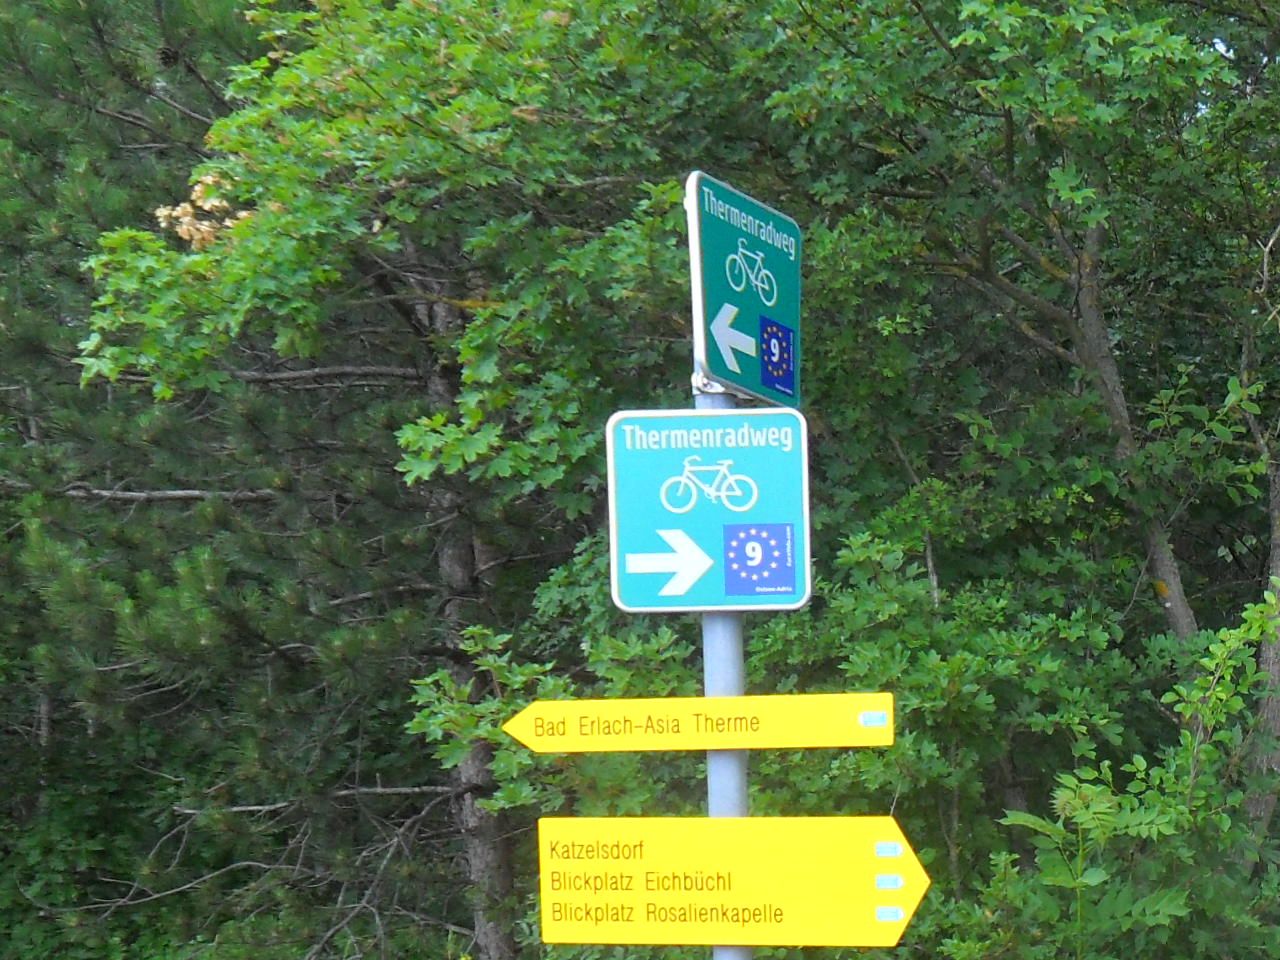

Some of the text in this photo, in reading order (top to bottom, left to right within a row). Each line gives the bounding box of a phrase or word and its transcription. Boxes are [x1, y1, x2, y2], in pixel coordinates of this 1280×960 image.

[702, 186, 797, 261] Thermenradweg
[769, 337, 780, 363] 9
[622, 423, 793, 453] Thermenradweg
[744, 540, 763, 567] 9
[534, 713, 761, 737] Bad Erlach-Asia Therme
[549, 840, 645, 860] Katzelsdorf
[551, 871, 733, 895] Blickplatz Eichbüchl
[552, 902, 784, 928] Blickplatz Rosalienkapelle
